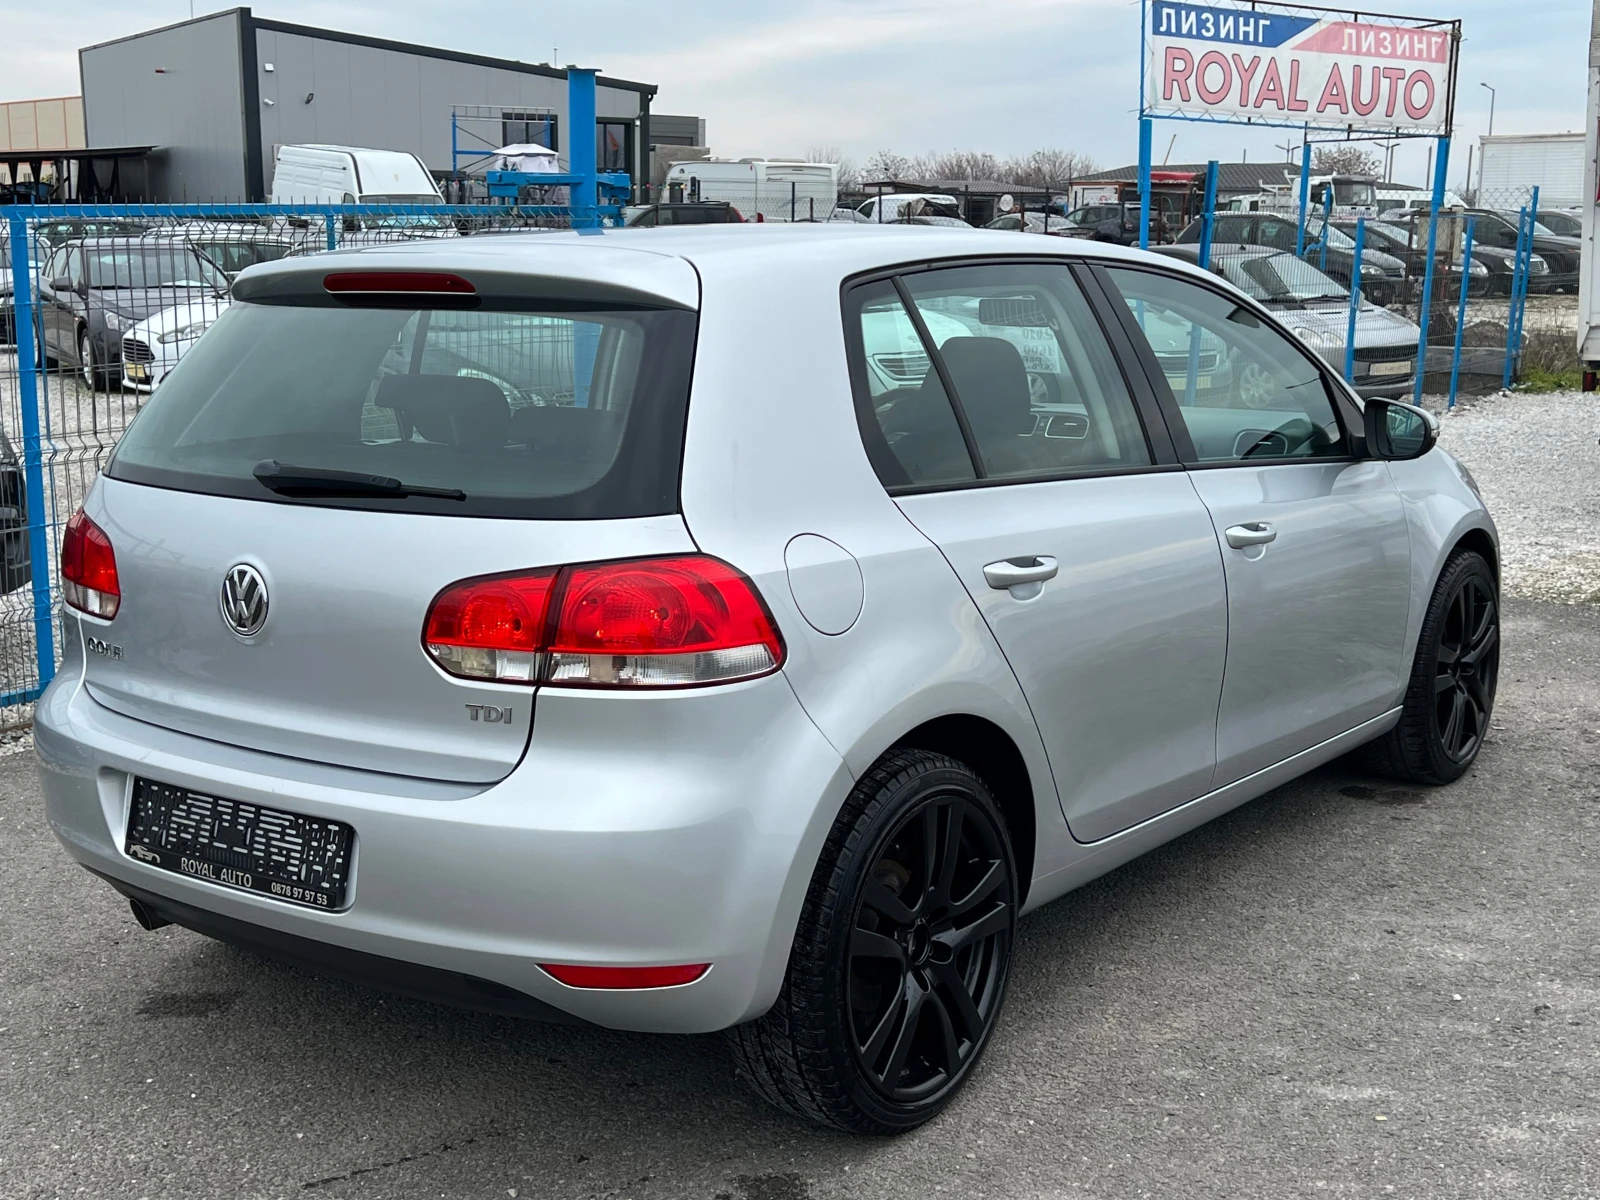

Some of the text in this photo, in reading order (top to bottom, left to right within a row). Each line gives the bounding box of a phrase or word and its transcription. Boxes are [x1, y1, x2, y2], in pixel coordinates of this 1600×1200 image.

[1159, 7, 1271, 43] ЛИЗИНГ
[1342, 28, 1442, 59] ЛИЗИНГ
[1162, 46, 1435, 120] ROYAL AUTO
[465, 702, 513, 724] TDI
[181, 857, 252, 888] ROYAL AUTO
[271, 882, 328, 906] 0878 97 97 53
